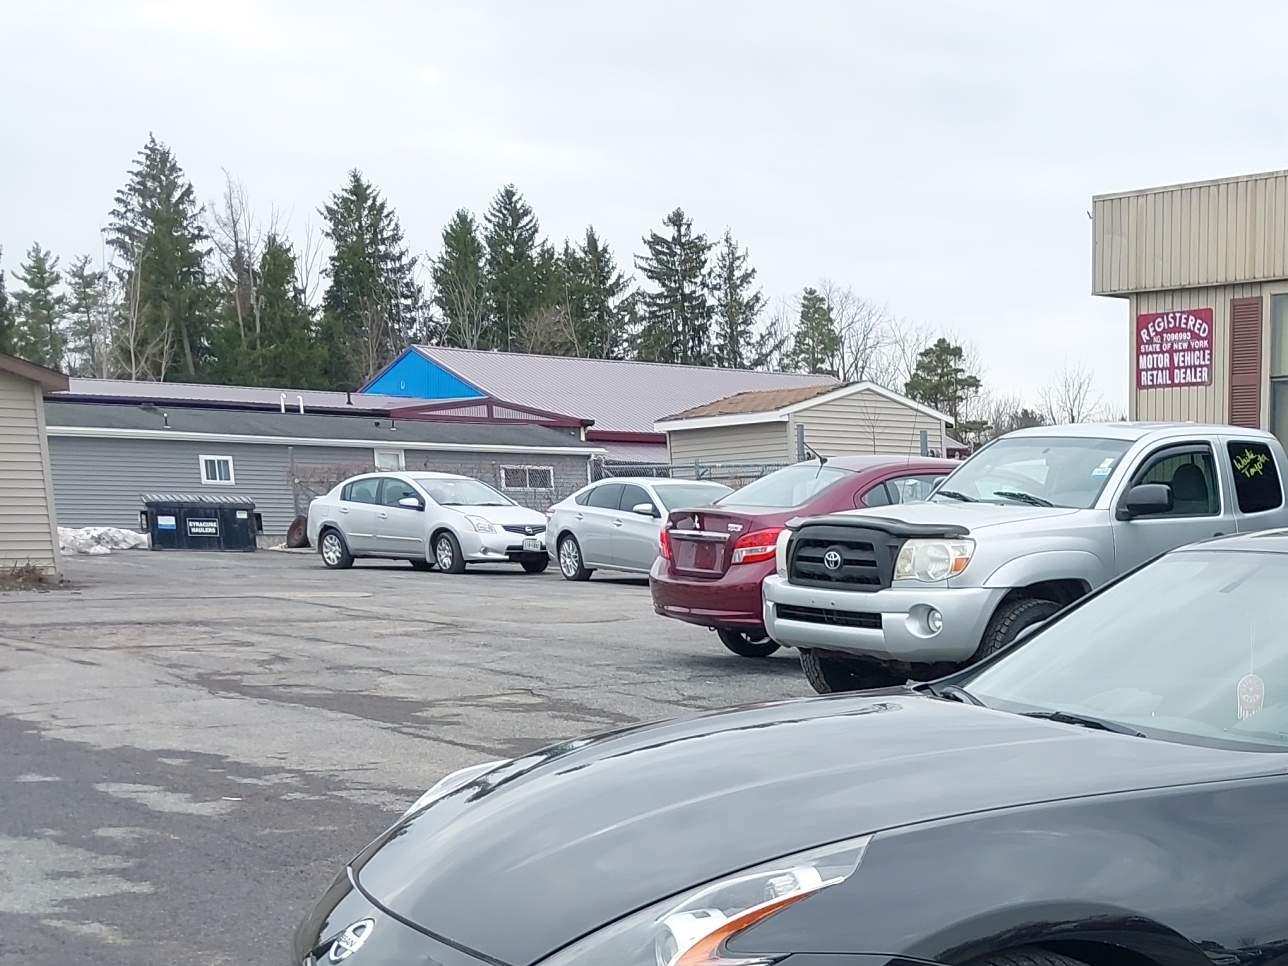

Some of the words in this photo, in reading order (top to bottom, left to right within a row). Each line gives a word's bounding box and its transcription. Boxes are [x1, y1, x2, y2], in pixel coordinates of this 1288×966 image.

[1140, 312, 1209, 343] REGISTERED
[1140, 343, 1161, 353] STATE
[1162, 342, 1172, 351] OF
[1173, 342, 1189, 350] NEW
[1190, 340, 1209, 349] YORK
[1139, 352, 1170, 370] MOTOR
[1173, 350, 1211, 367] VEHICLE
[1141, 369, 1171, 386] RETAIL
[1173, 367, 1209, 384] DEALER
